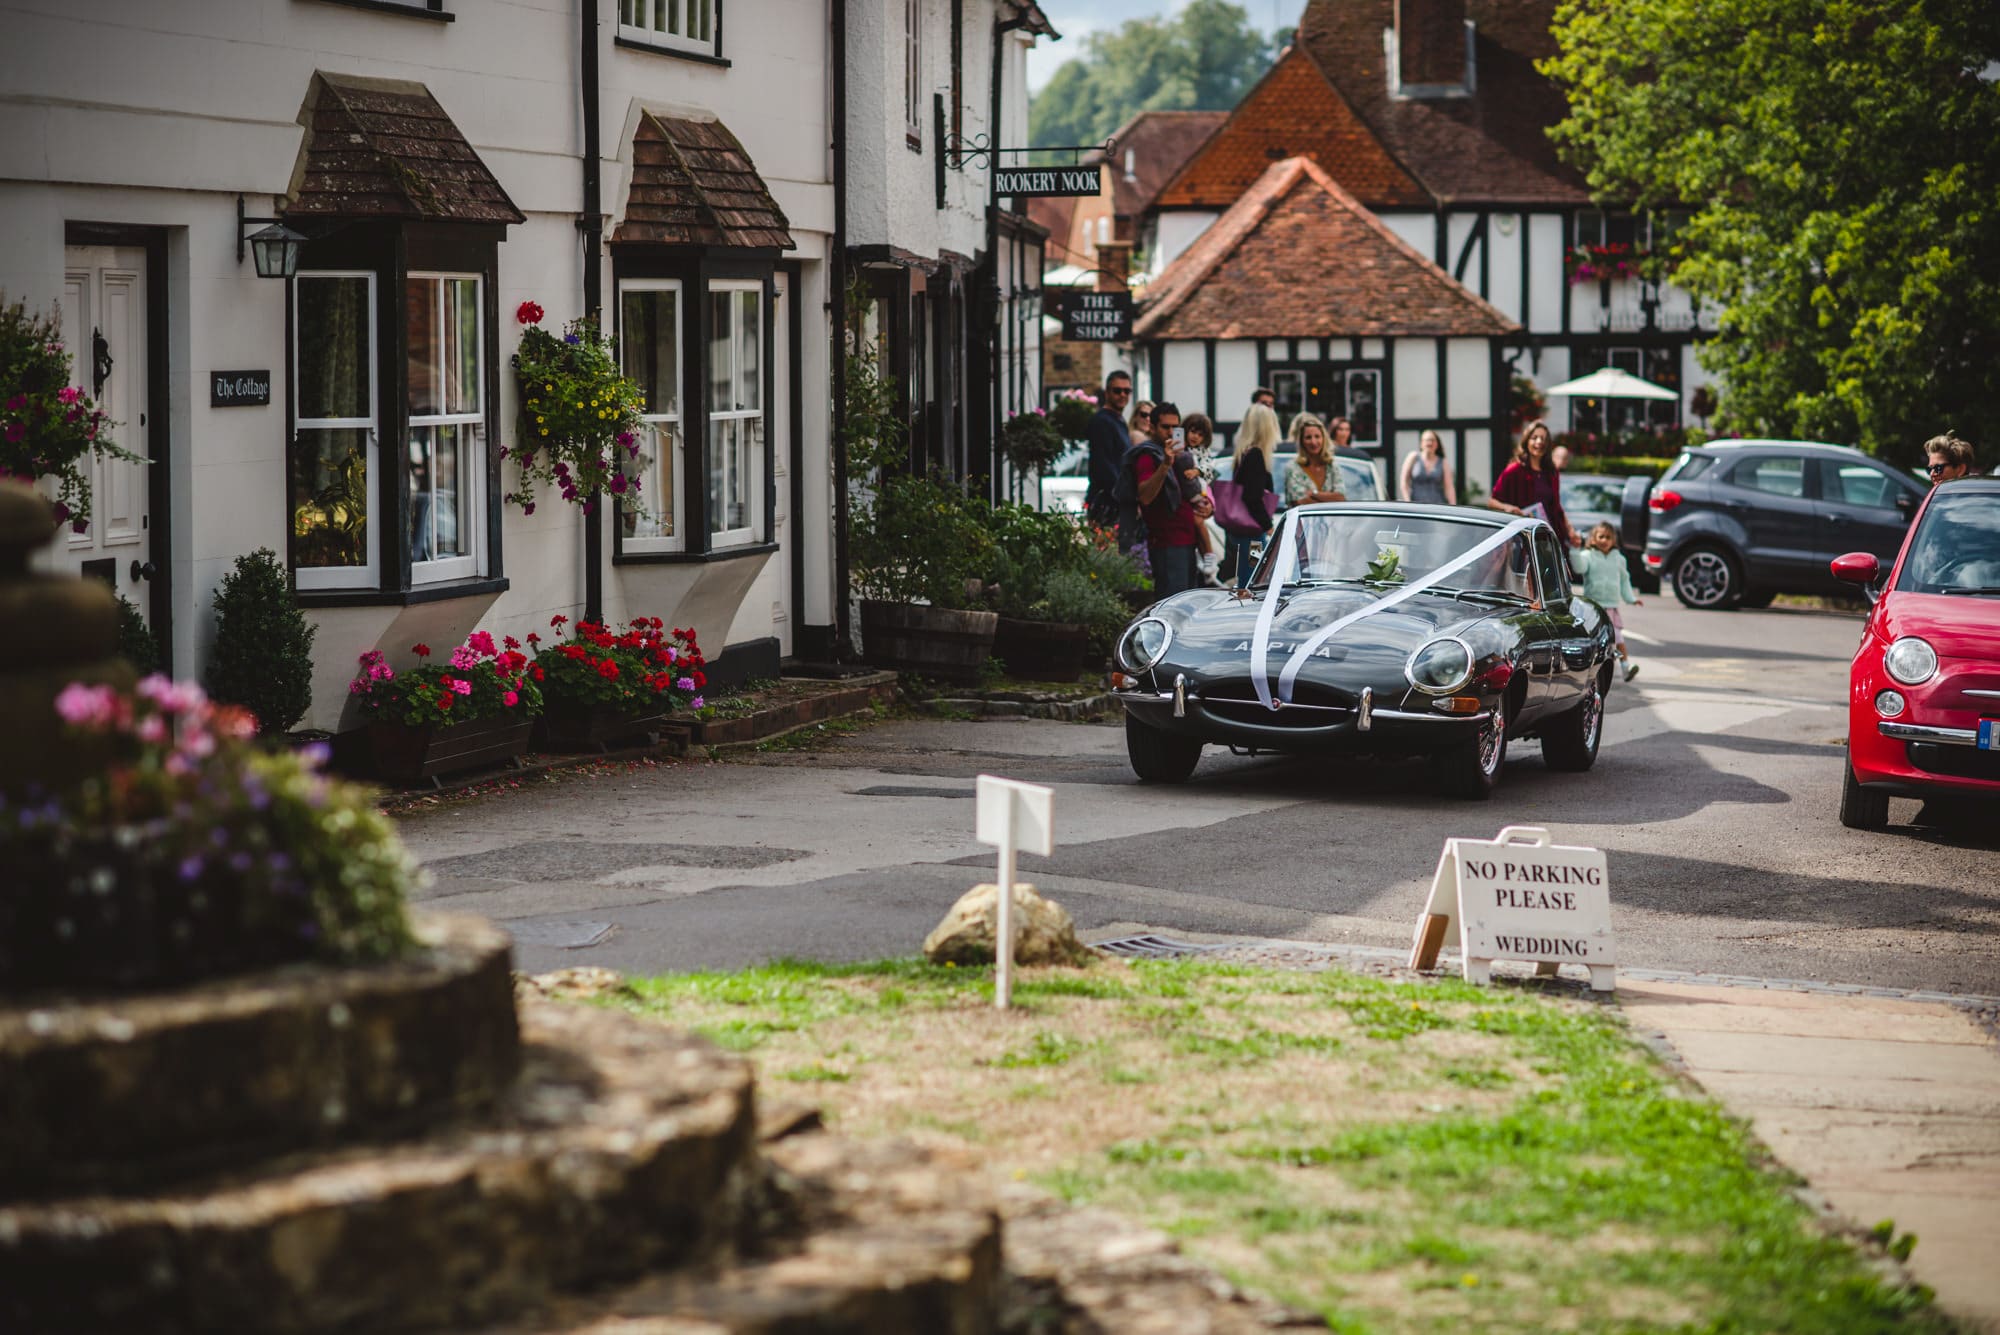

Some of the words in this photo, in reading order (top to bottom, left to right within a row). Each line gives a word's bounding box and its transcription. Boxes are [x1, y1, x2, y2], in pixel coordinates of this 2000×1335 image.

[996, 172, 1057, 192] ROOKERY
[1062, 171, 1099, 191] NOOK
[1081, 295, 1113, 308] THE
[1071, 310, 1123, 323] SHERE
[1076, 325, 1119, 338] SHOP
[216, 377, 234, 399] The
[235, 376, 268, 400] Cottage
[1233, 640, 1284, 652] AP
[1465, 860, 1497, 880] NO
[1504, 862, 1601, 886] PARKING
[1495, 888, 1577, 911] PLEASE
[1495, 935, 1588, 957] WEDDING
